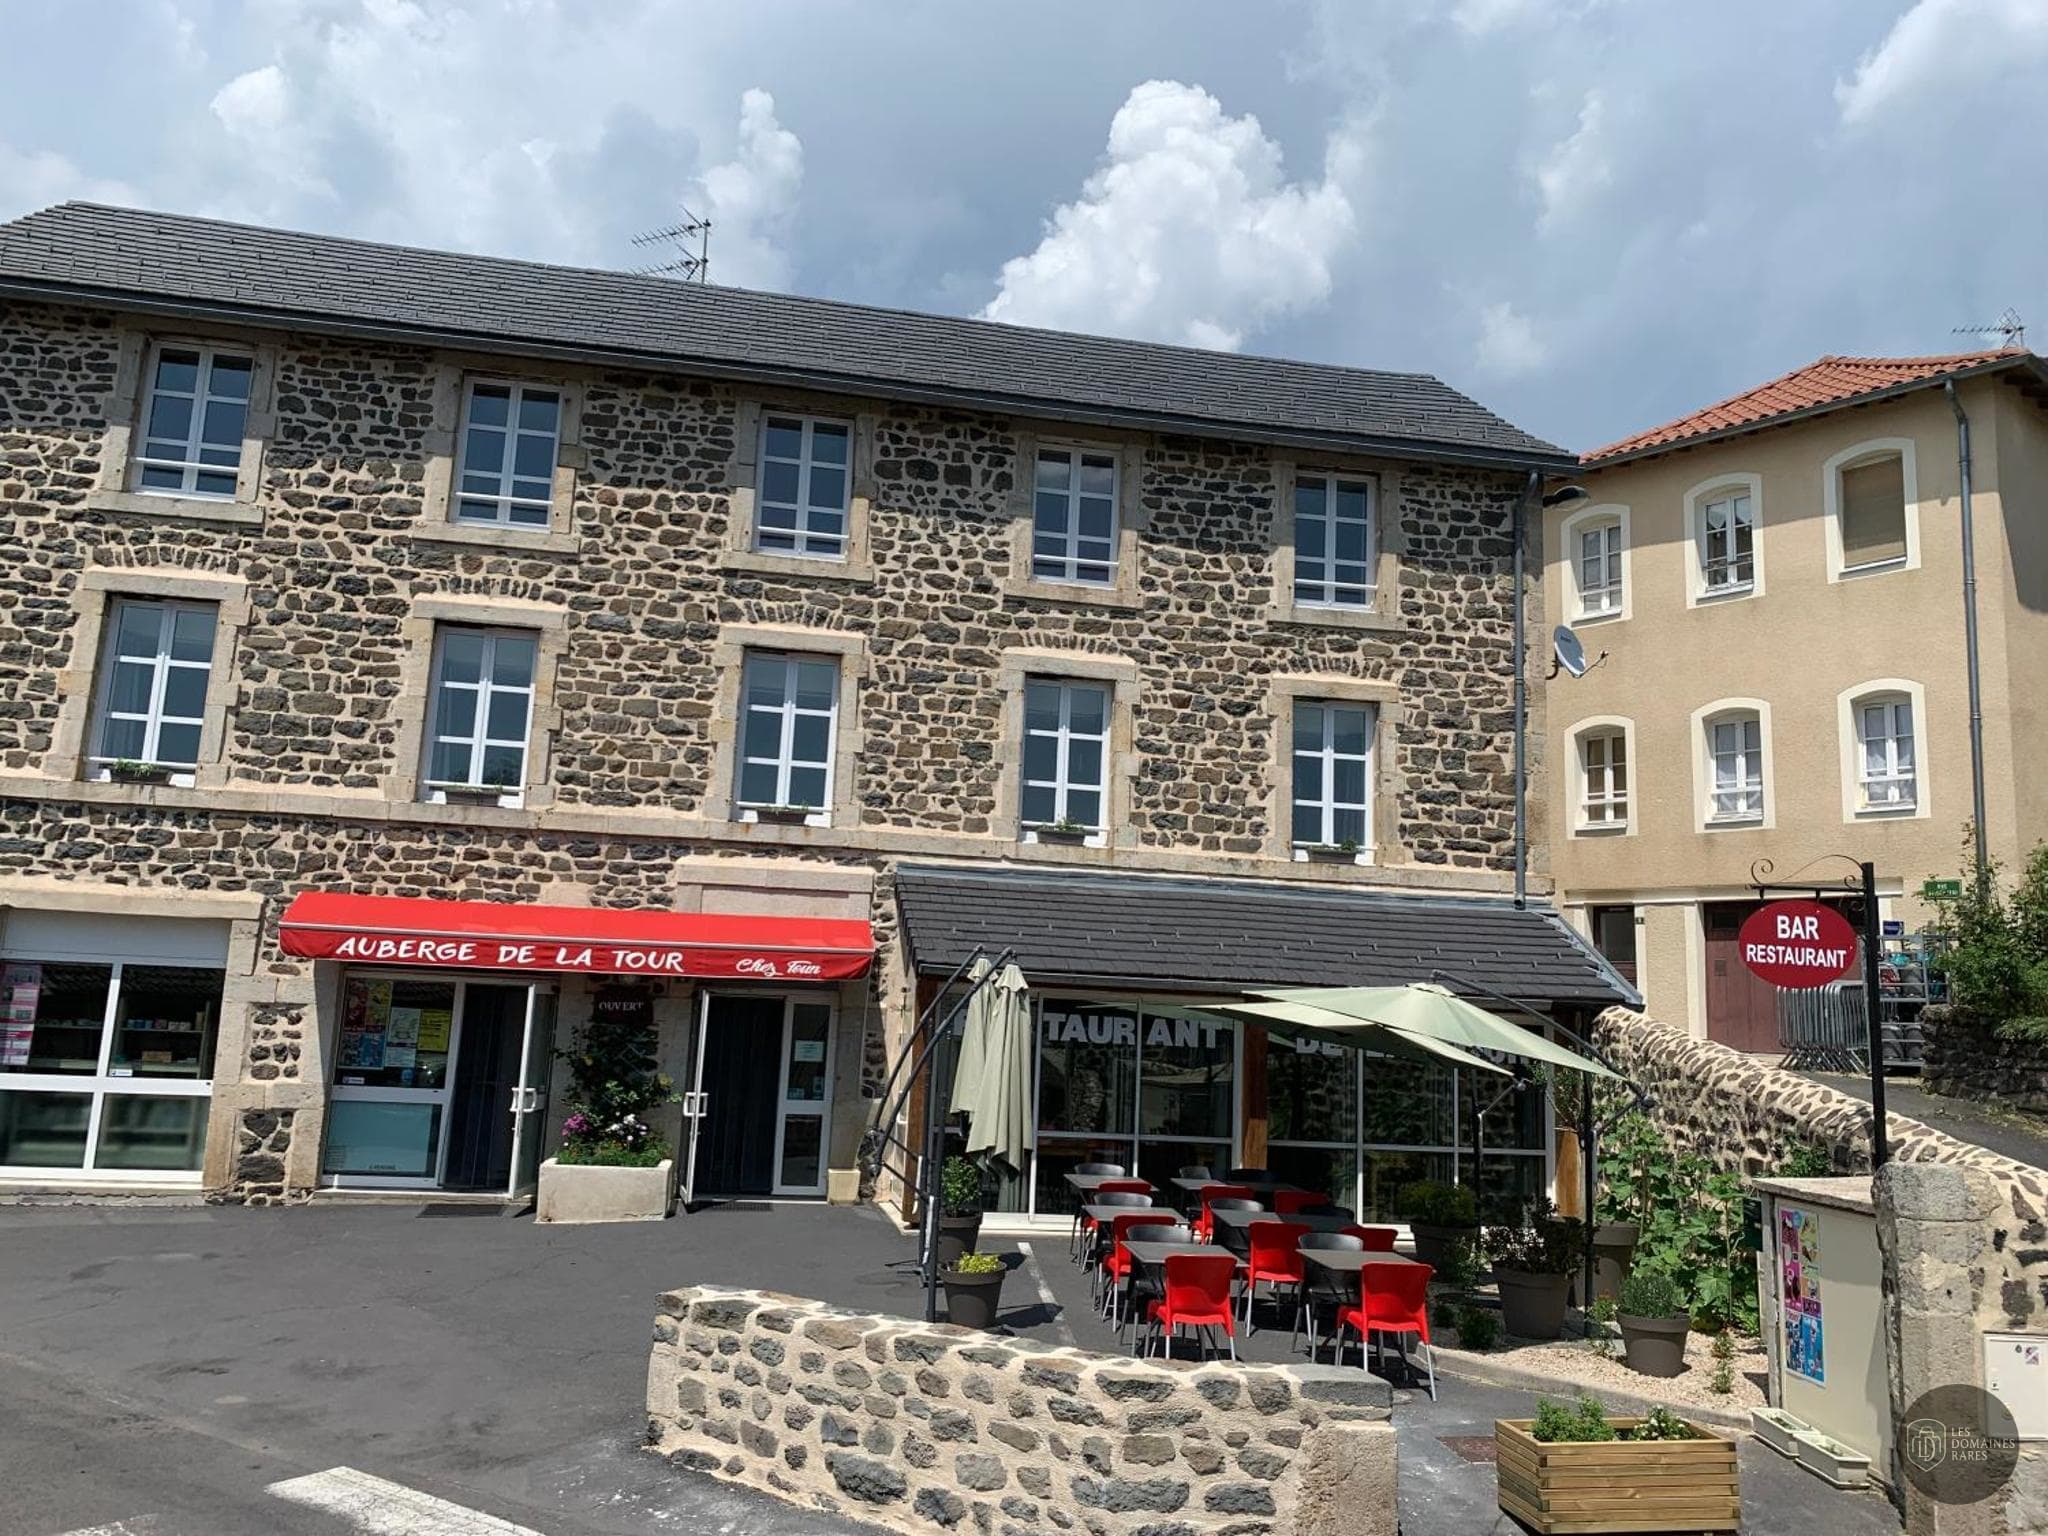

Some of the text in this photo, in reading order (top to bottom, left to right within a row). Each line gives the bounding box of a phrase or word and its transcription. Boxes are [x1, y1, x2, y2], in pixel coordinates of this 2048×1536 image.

[1776, 915, 1819, 940] BAR
[336, 937, 684, 973] AUBERGE DE LA TOUR
[735, 958, 783, 977] Chez
[1746, 944, 1846, 968] RESTAURANT
[953, 1008, 1223, 1049] TAURANT
